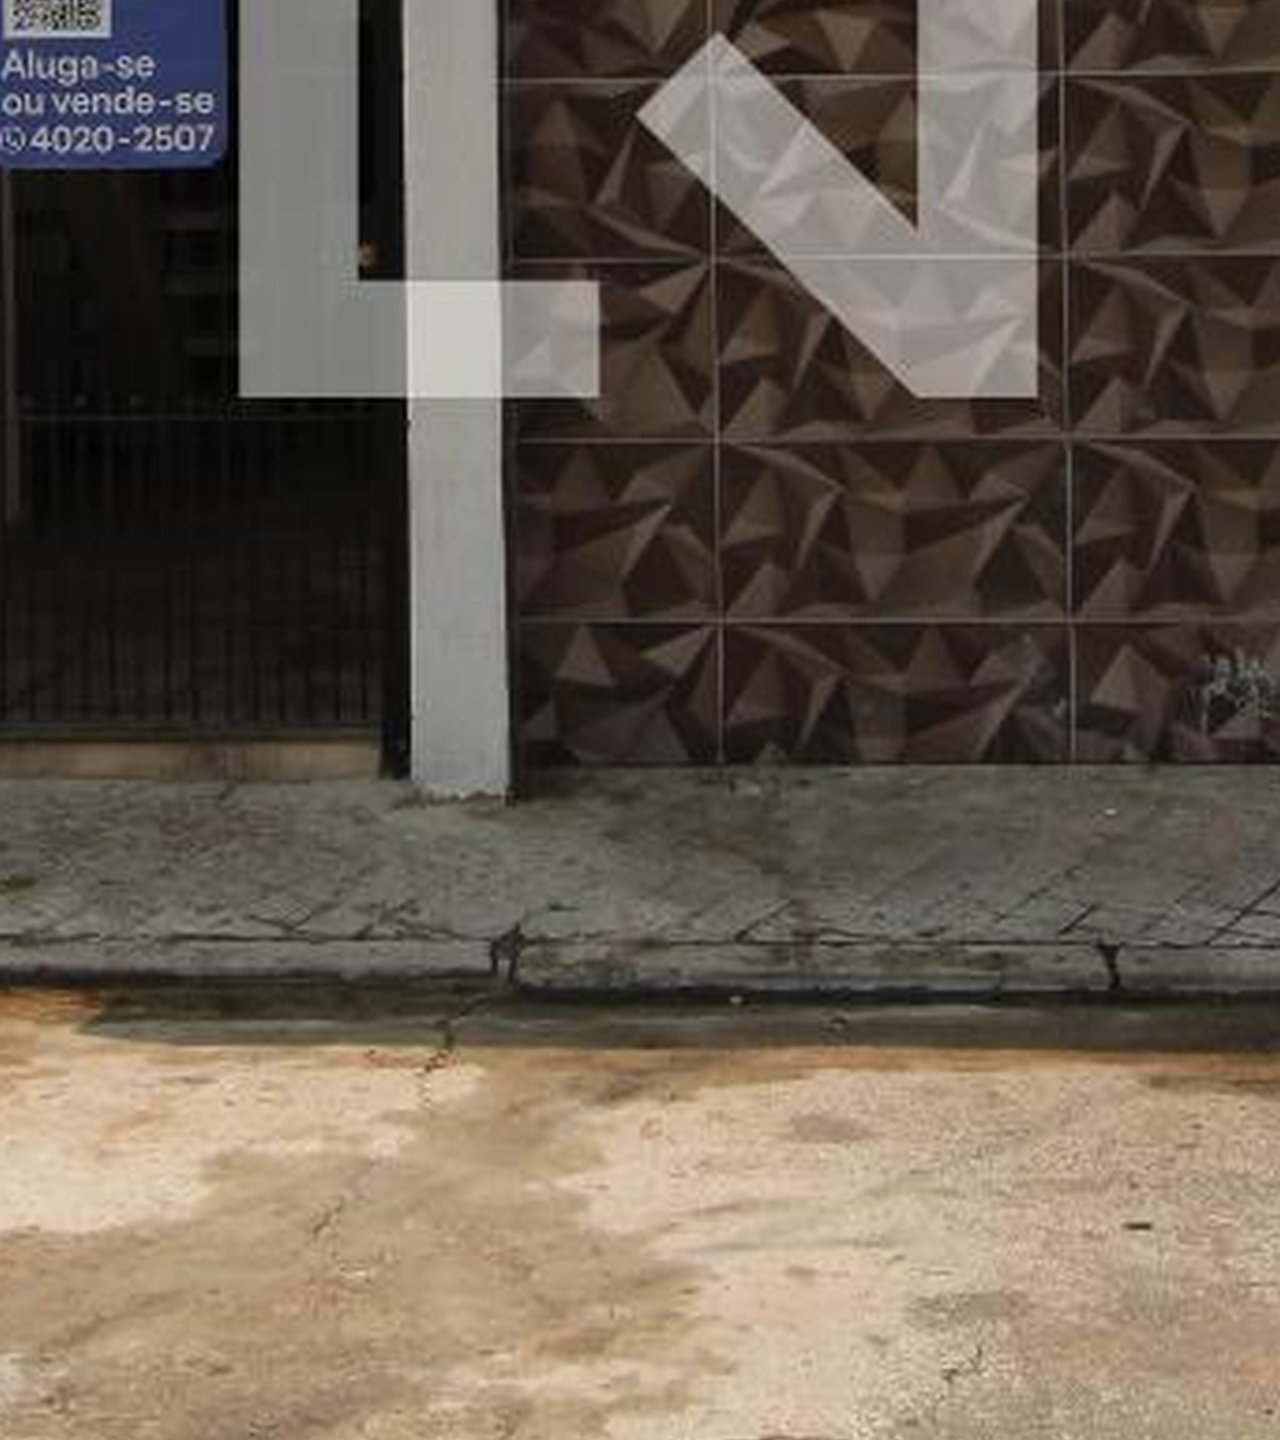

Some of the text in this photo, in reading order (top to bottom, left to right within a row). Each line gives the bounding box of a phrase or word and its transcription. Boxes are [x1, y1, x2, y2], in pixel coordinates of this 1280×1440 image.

[0, 50, 155, 86] Aluga-se
[1, 86, 215, 116] ou vende-se
[30, 125, 215, 153] 4020-2507
